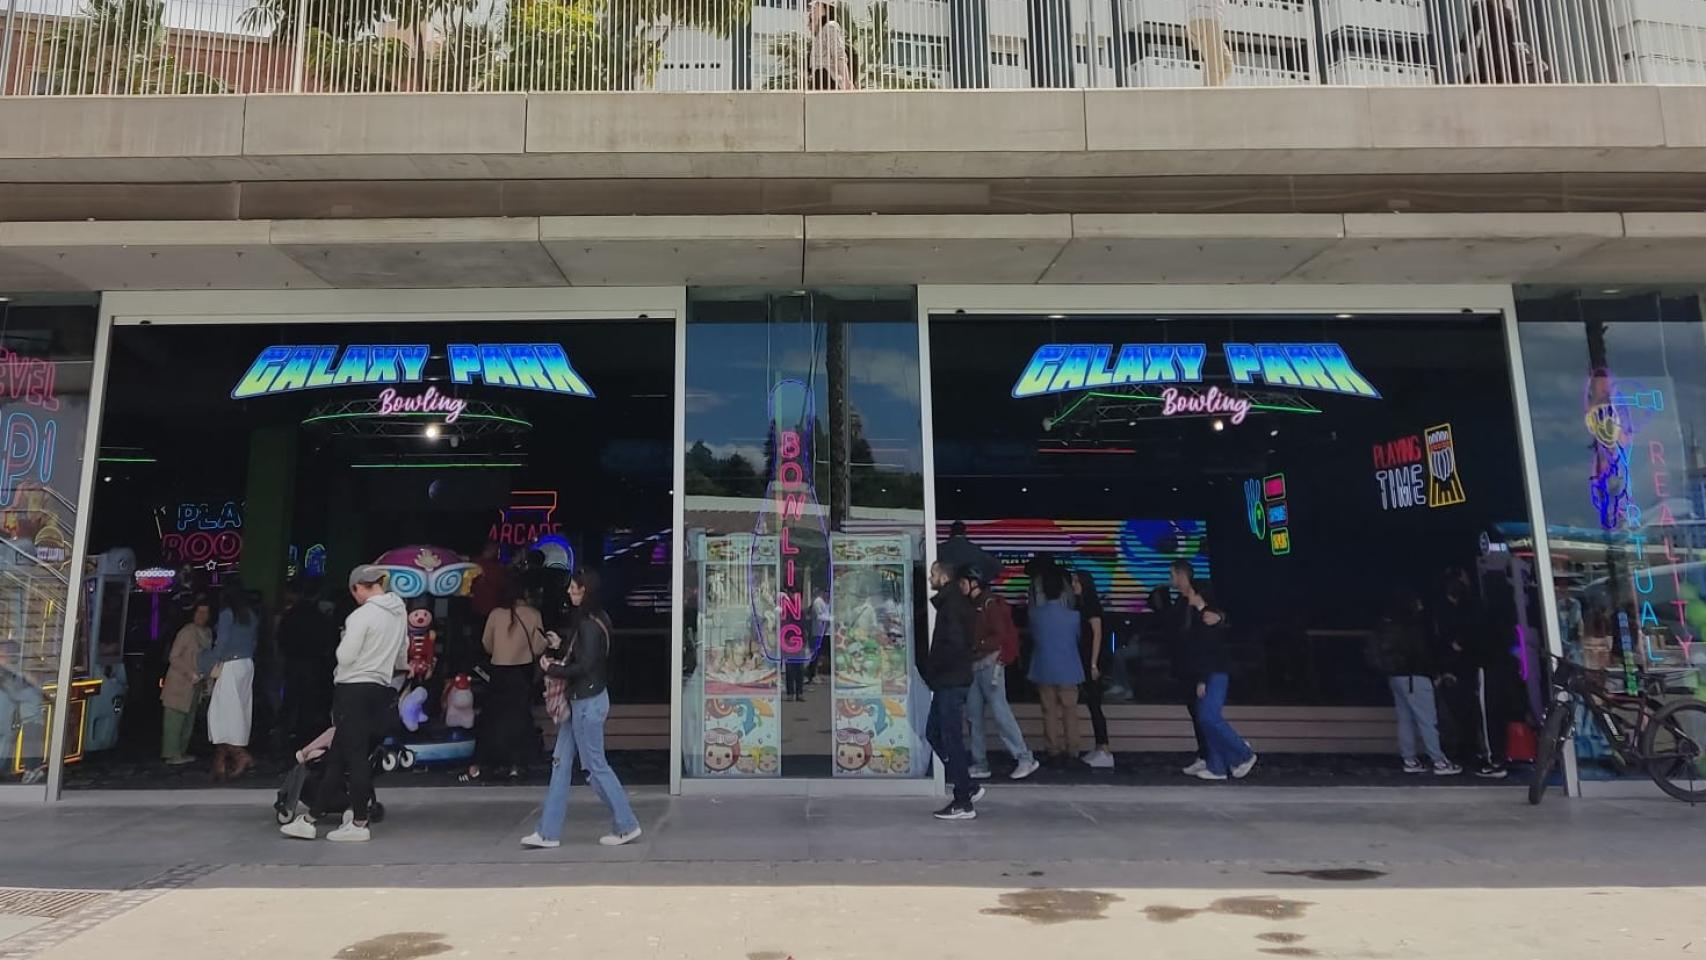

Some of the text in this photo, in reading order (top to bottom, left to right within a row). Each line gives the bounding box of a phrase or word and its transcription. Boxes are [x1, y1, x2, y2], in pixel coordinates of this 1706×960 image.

[231, 343, 597, 399] GALAXY PARK
[1011, 342, 1383, 399] GALAXY PARK
[378, 386, 467, 424] Bowling
[1161, 386, 1251, 424] Bowling
[1375, 464, 1426, 510] TIME
[177, 501, 245, 531] PLA
[161, 531, 242, 562] ROO
[778, 431, 804, 655] BOWLING
[1649, 440, 1696, 662] REALITY
